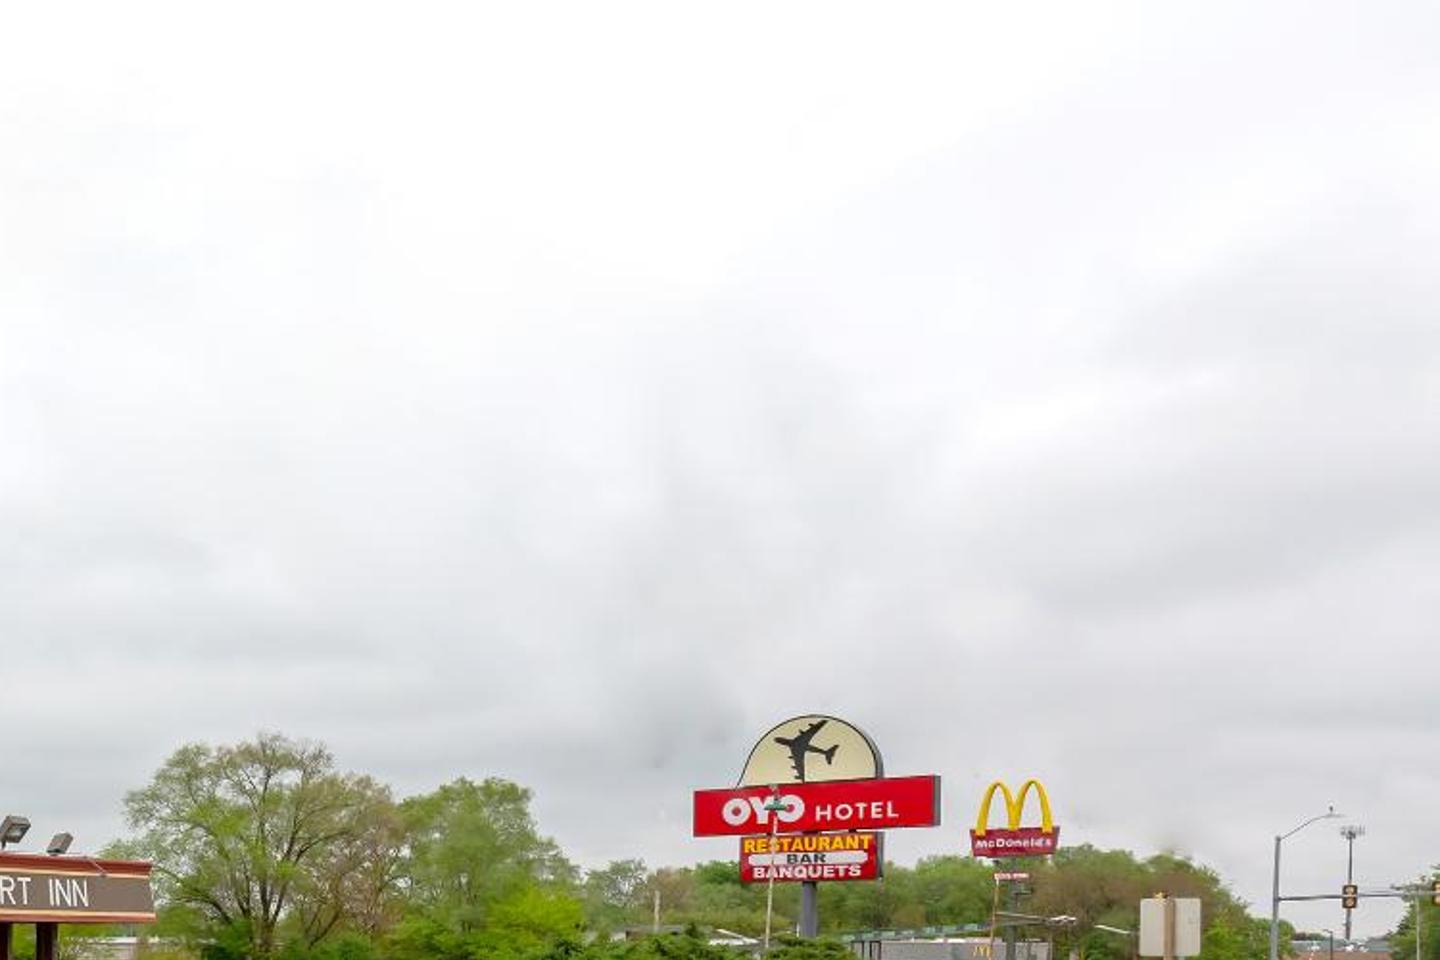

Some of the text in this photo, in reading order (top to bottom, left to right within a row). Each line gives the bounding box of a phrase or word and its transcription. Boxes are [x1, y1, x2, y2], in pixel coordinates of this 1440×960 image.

[722, 794, 899, 826] OYO HOTEL
[744, 834, 873, 853] RESTAURANT
[786, 853, 826, 865] BAR
[753, 865, 861, 879] BANQUETS
[48, 878, 90, 908] INN
